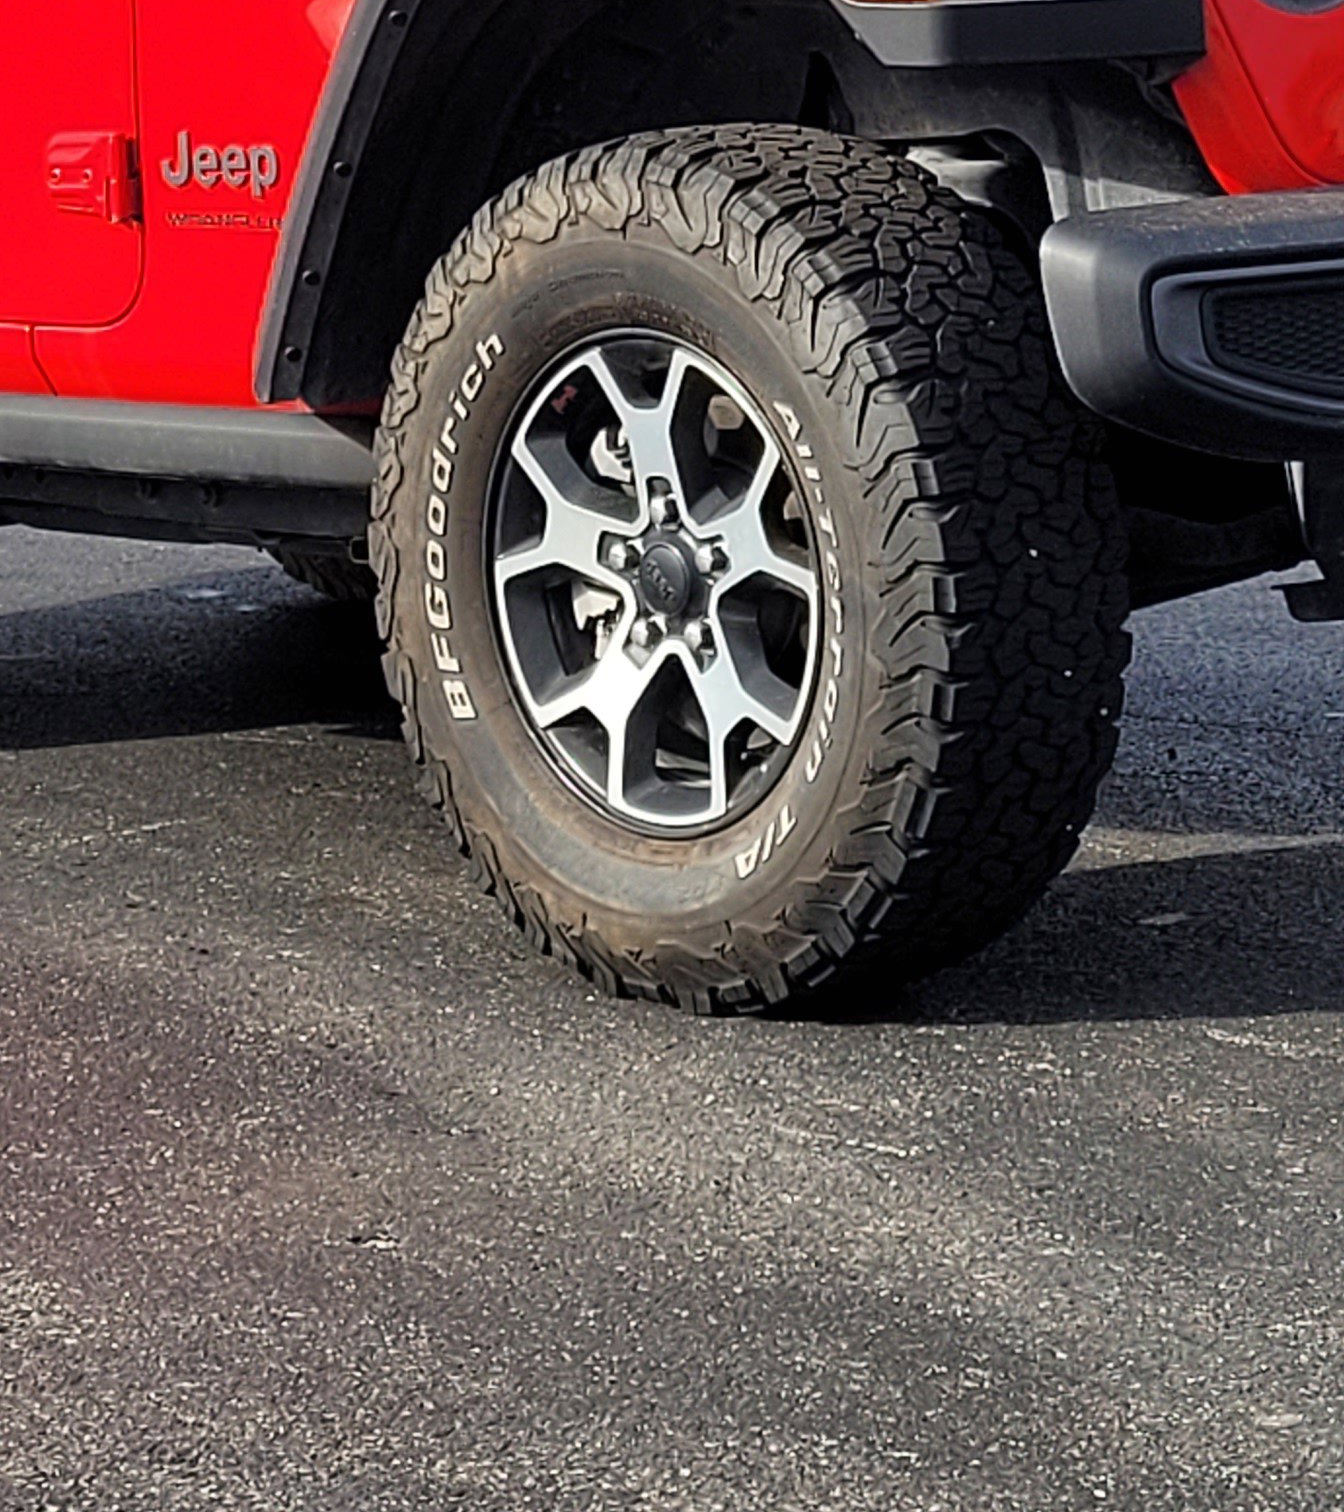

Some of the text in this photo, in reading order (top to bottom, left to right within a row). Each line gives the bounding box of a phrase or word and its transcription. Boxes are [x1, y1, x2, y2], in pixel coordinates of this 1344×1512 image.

[160, 129, 278, 199] Jeep
[423, 332, 505, 721] BFGoodrich
[734, 804, 799, 881] T/A
